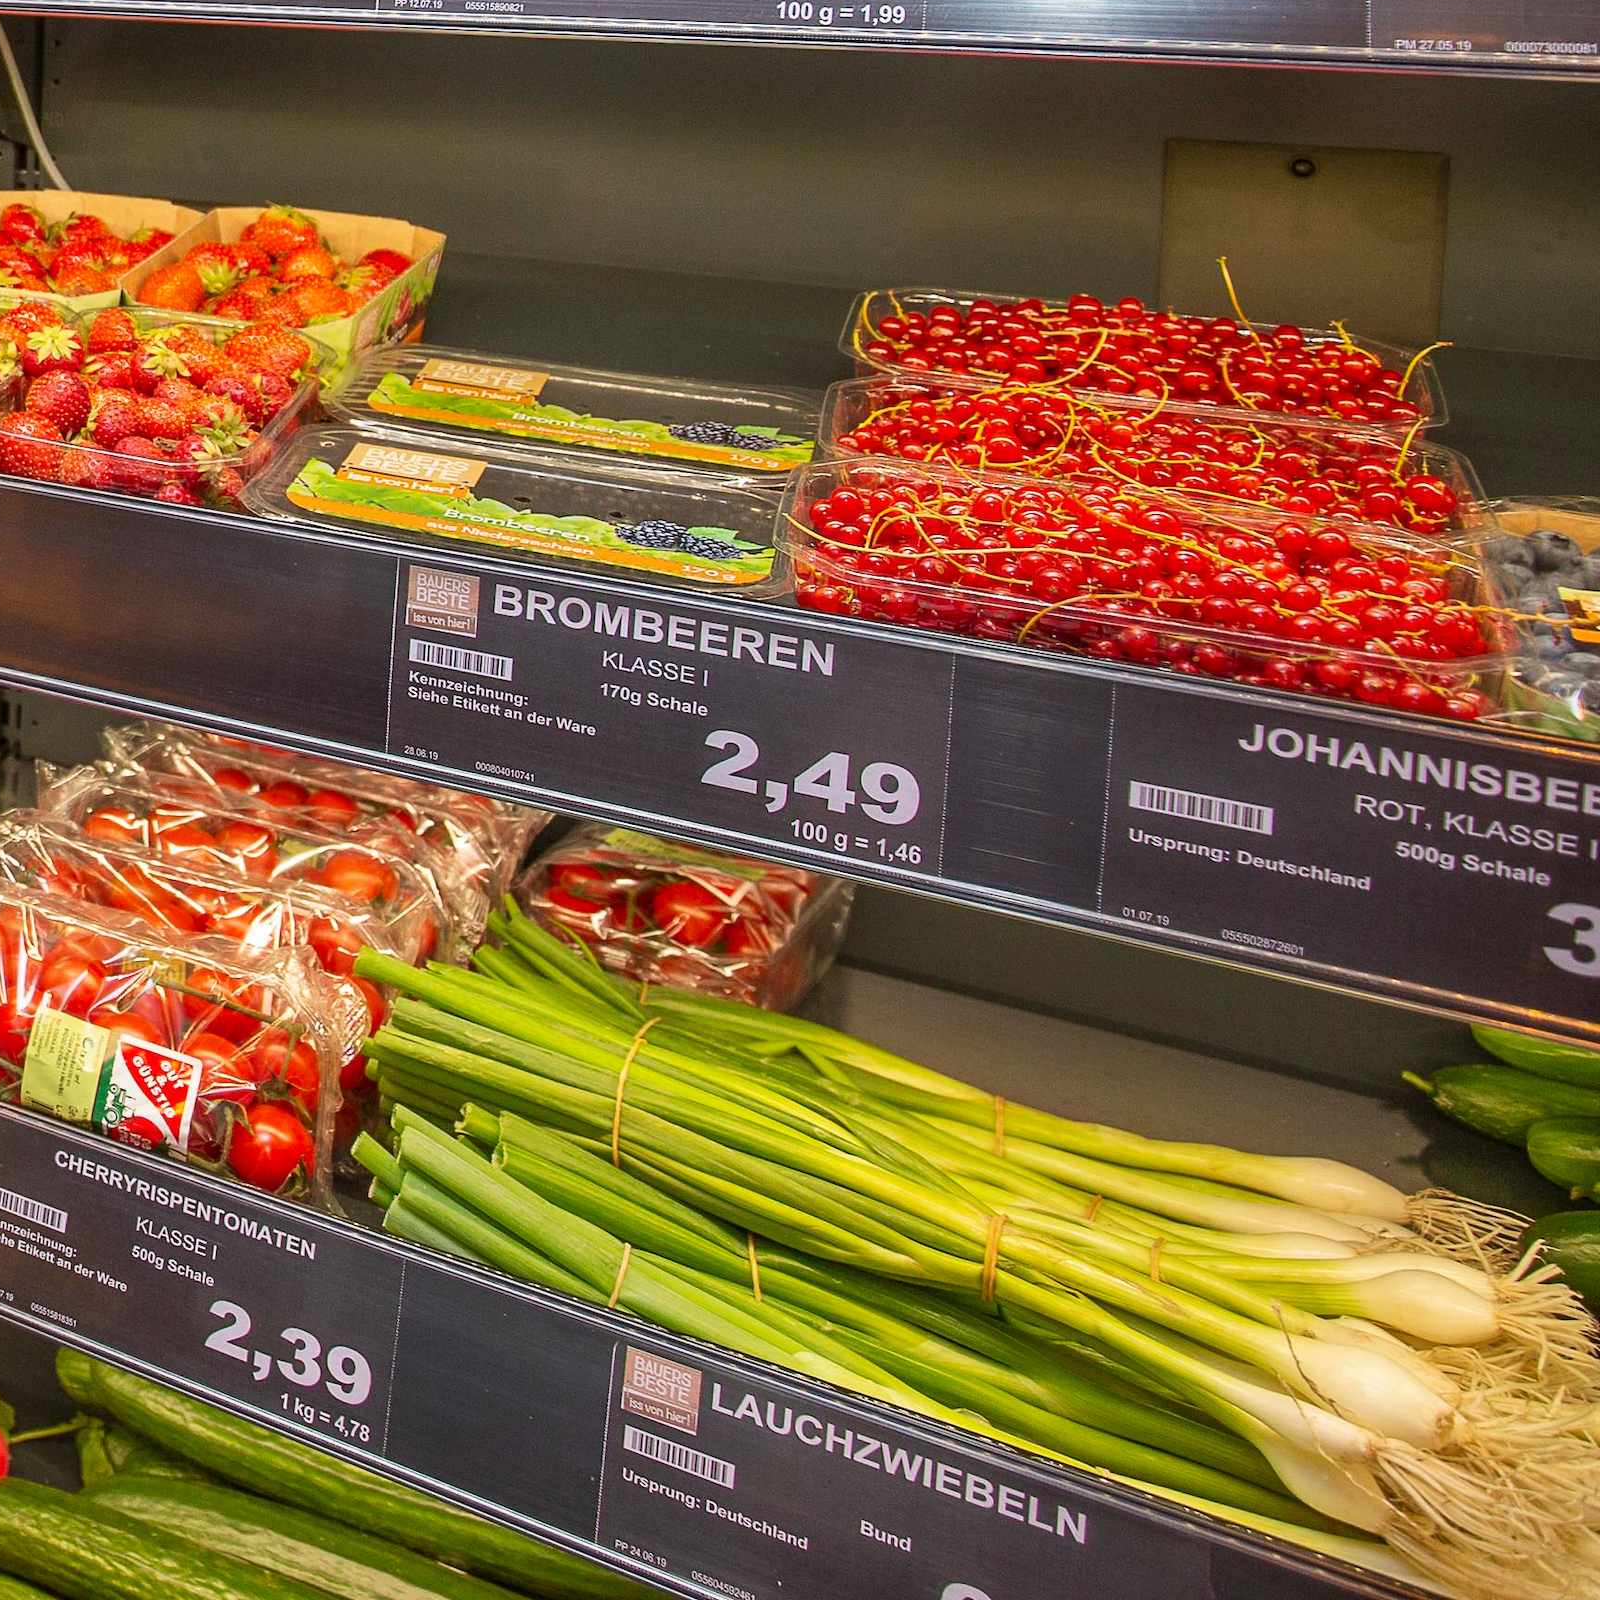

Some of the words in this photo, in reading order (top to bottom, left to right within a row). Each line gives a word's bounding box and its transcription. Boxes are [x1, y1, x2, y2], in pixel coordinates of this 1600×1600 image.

[775, 0, 814, 21] 100
[860, 3, 906, 25] 1,99
[363, 459, 462, 482] BESTE
[443, 508, 592, 544] Brombeeren
[467, 526, 595, 557] Niedersachsen
[415, 588, 471, 612] BESTE
[493, 584, 836, 678] BROMBEEREN
[408, 670, 530, 707] Kennzeichnung:
[601, 650, 696, 685] KLASSE
[599, 683, 643, 707] 170g
[646, 691, 709, 718] Schale
[700, 729, 922, 826] 2,49
[789, 818, 829, 845] 100
[875, 837, 922, 865] 1,46
[1354, 793, 1433, 830] ROT,
[1442, 810, 1580, 856] KLASSE
[1127, 827, 1231, 863] Ursprung:
[1236, 849, 1372, 892] Deutschland
[1395, 841, 1457, 871] 500g
[1461, 854, 1552, 888] Schale
[132, 1055, 176, 1118] GÜNSTIG
[53, 1150, 317, 1260] CHERRYRISPENTOMATEN
[135, 1216, 207, 1257] KLASSE
[131, 1244, 166, 1270] 500g
[167, 1259, 215, 1288] Schale
[203, 1299, 372, 1405] 2,39
[631, 1371, 693, 1405] BESTE
[333, 1415, 371, 1443] 4,78
[710, 1382, 1088, 1545] LAUCHZWIEBELN
[621, 1467, 702, 1510] Ursprung:
[704, 1498, 810, 1553] Deutschland
[858, 1519, 913, 1554] Bund
